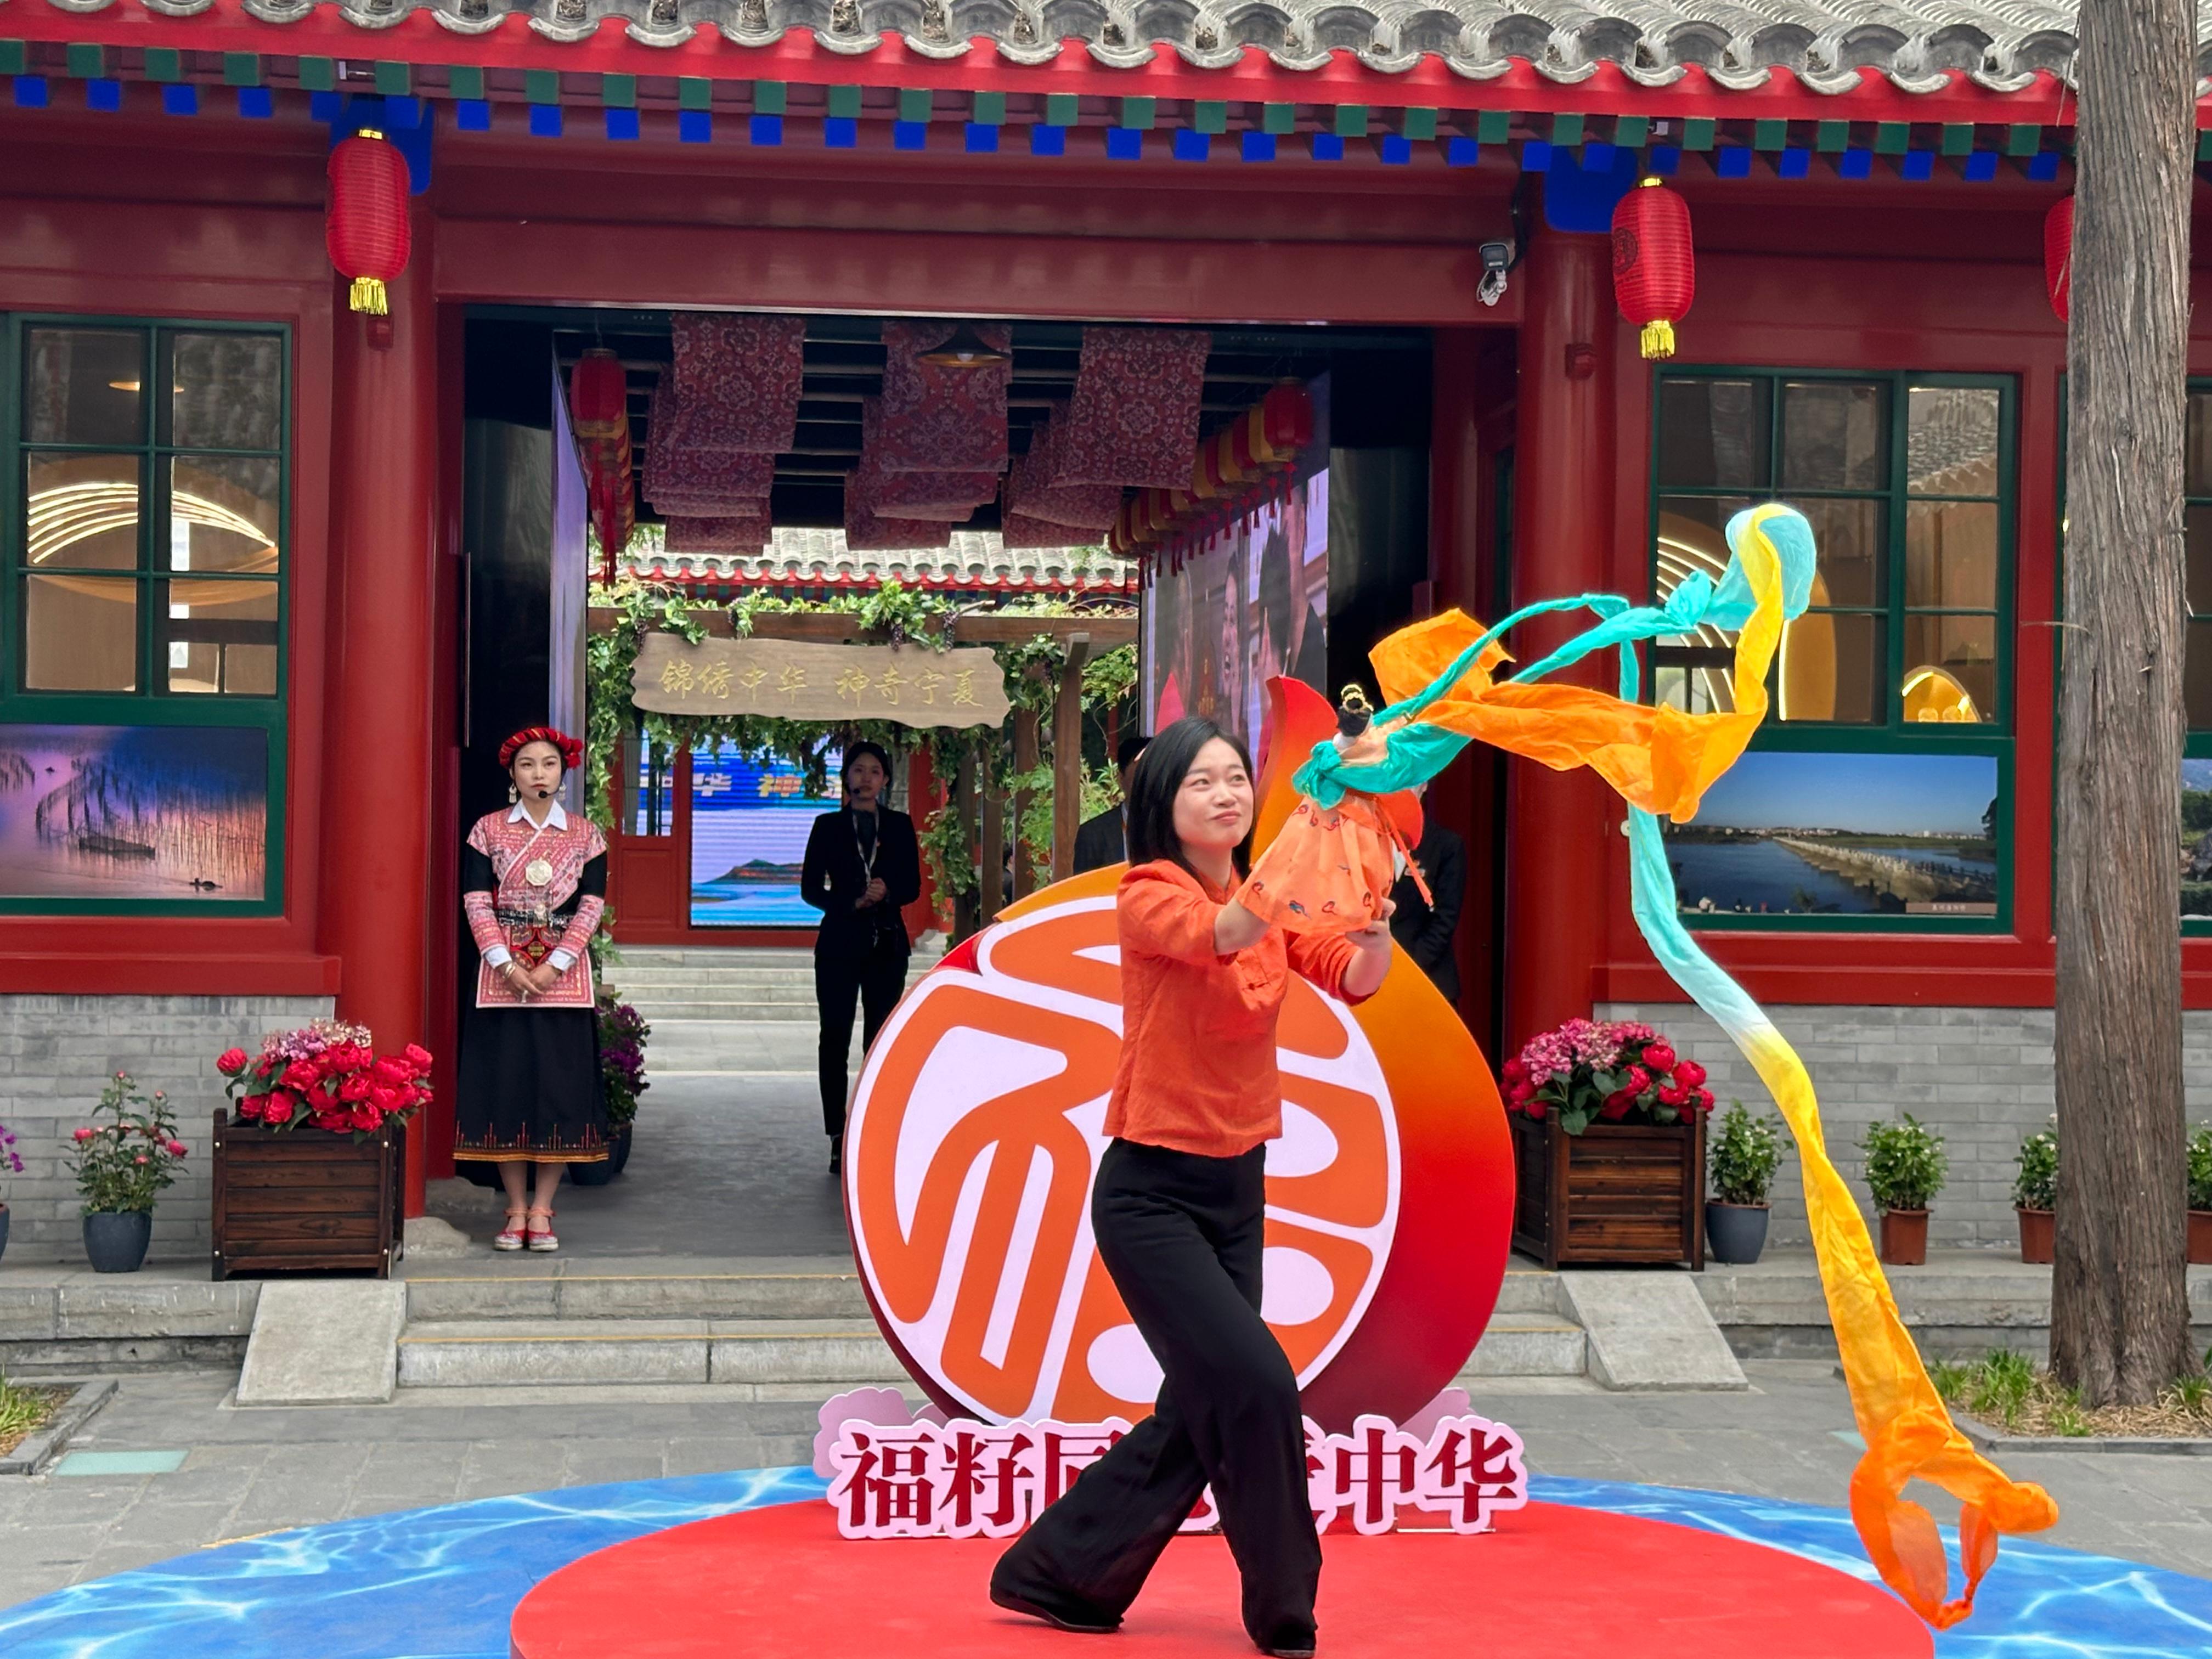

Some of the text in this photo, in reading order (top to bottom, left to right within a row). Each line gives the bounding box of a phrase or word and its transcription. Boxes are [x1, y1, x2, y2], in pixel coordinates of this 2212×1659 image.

[659, 658, 985, 707] 锦绣中华 神奇宁夏
[839, 1429, 1518, 1527] 福籽中华
